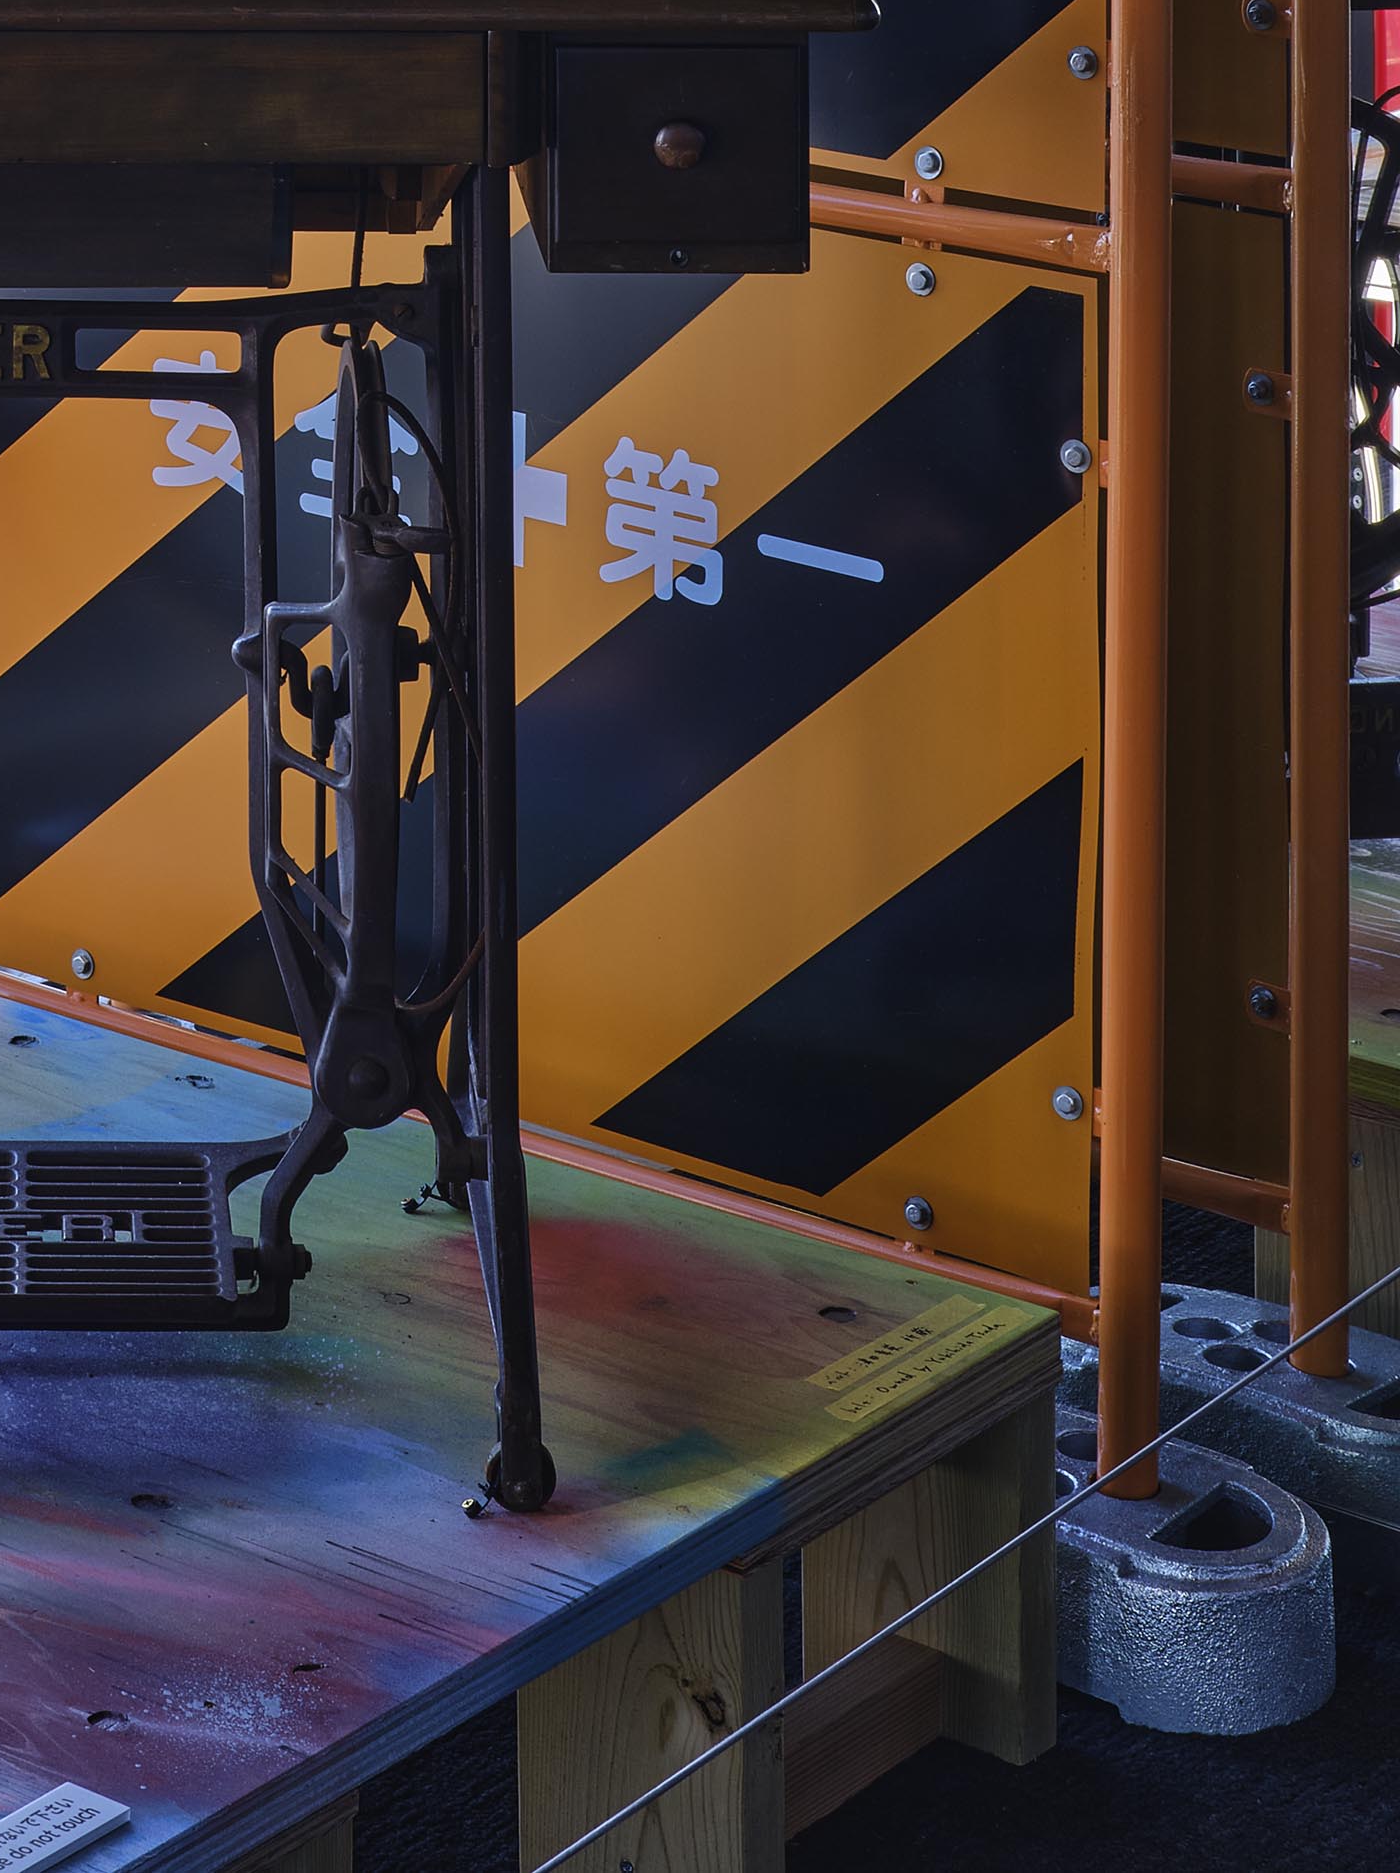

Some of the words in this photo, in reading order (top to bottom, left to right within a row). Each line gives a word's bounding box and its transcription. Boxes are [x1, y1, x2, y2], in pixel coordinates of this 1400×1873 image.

[10, 1846, 33, 1860] do
[30, 1828, 61, 1848] not
[53, 1806, 102, 1833] touch
